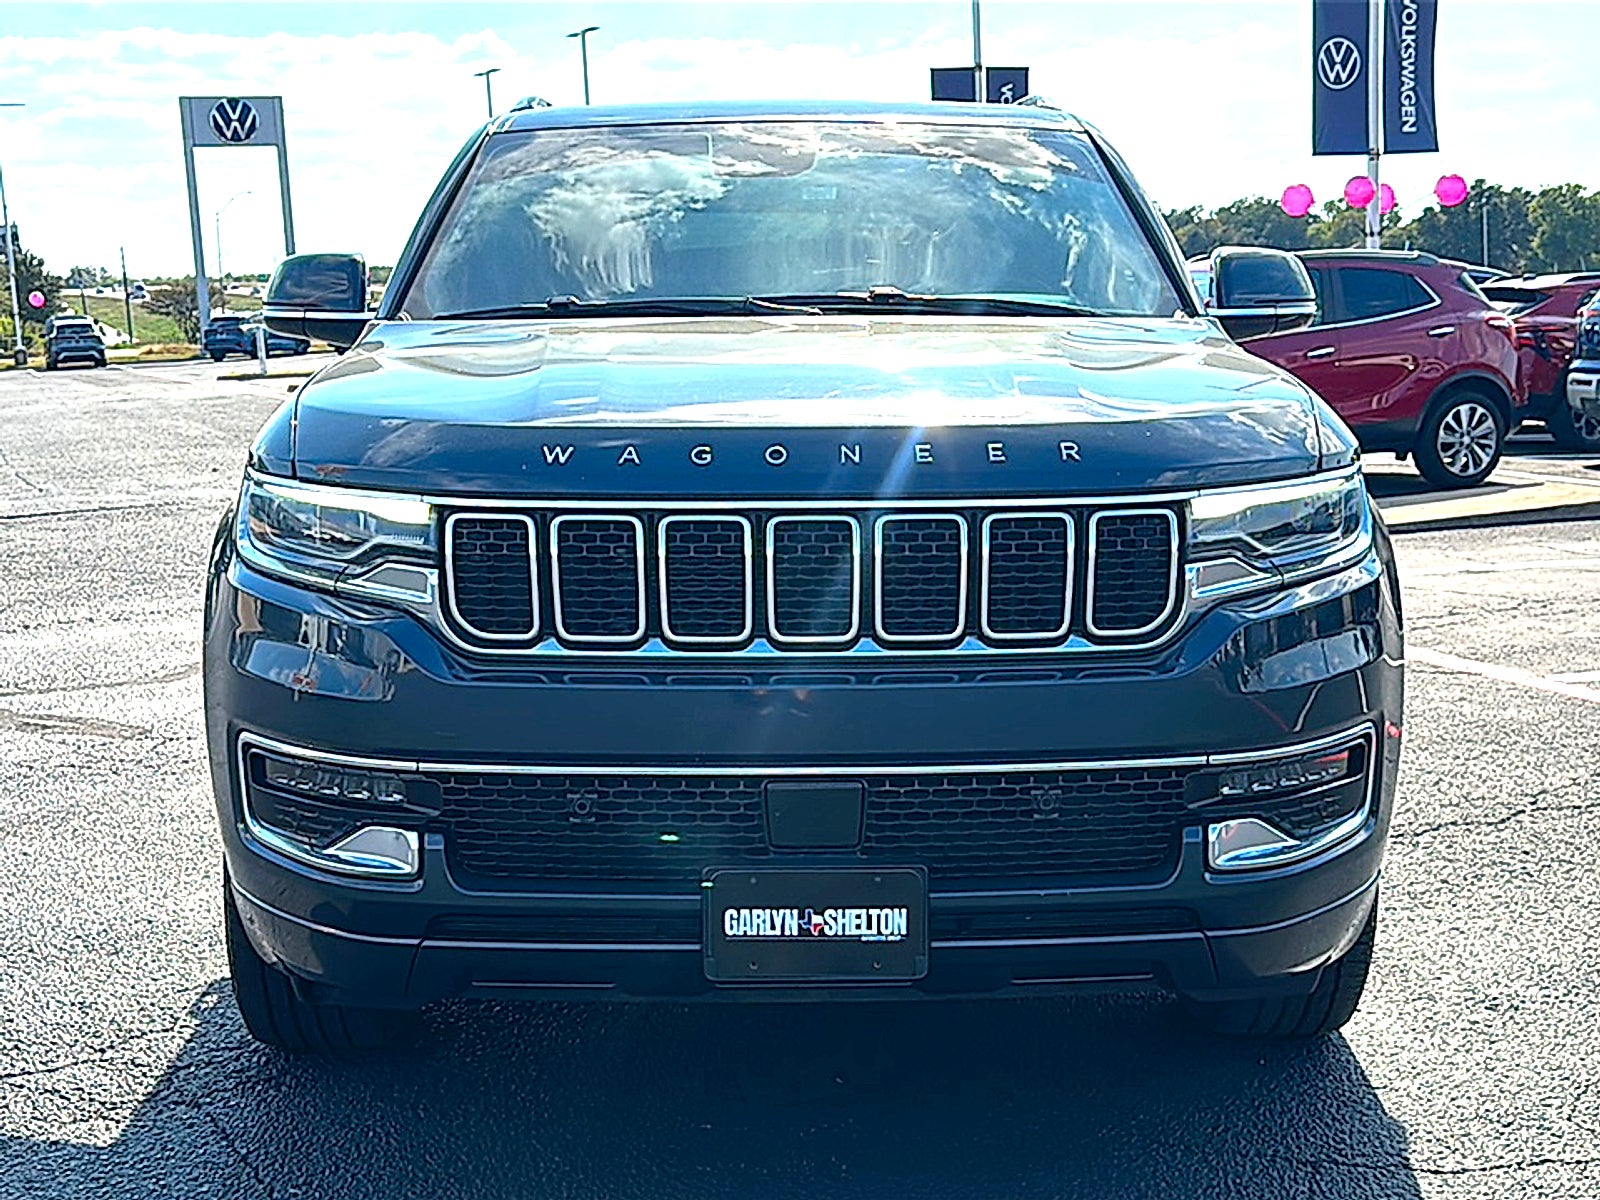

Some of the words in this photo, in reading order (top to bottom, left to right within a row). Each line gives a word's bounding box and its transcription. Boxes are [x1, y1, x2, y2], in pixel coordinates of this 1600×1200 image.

[542, 441, 1082, 464] WAGONEER
[724, 908, 799, 936] GARLYN
[823, 907, 908, 936] SHELTON
